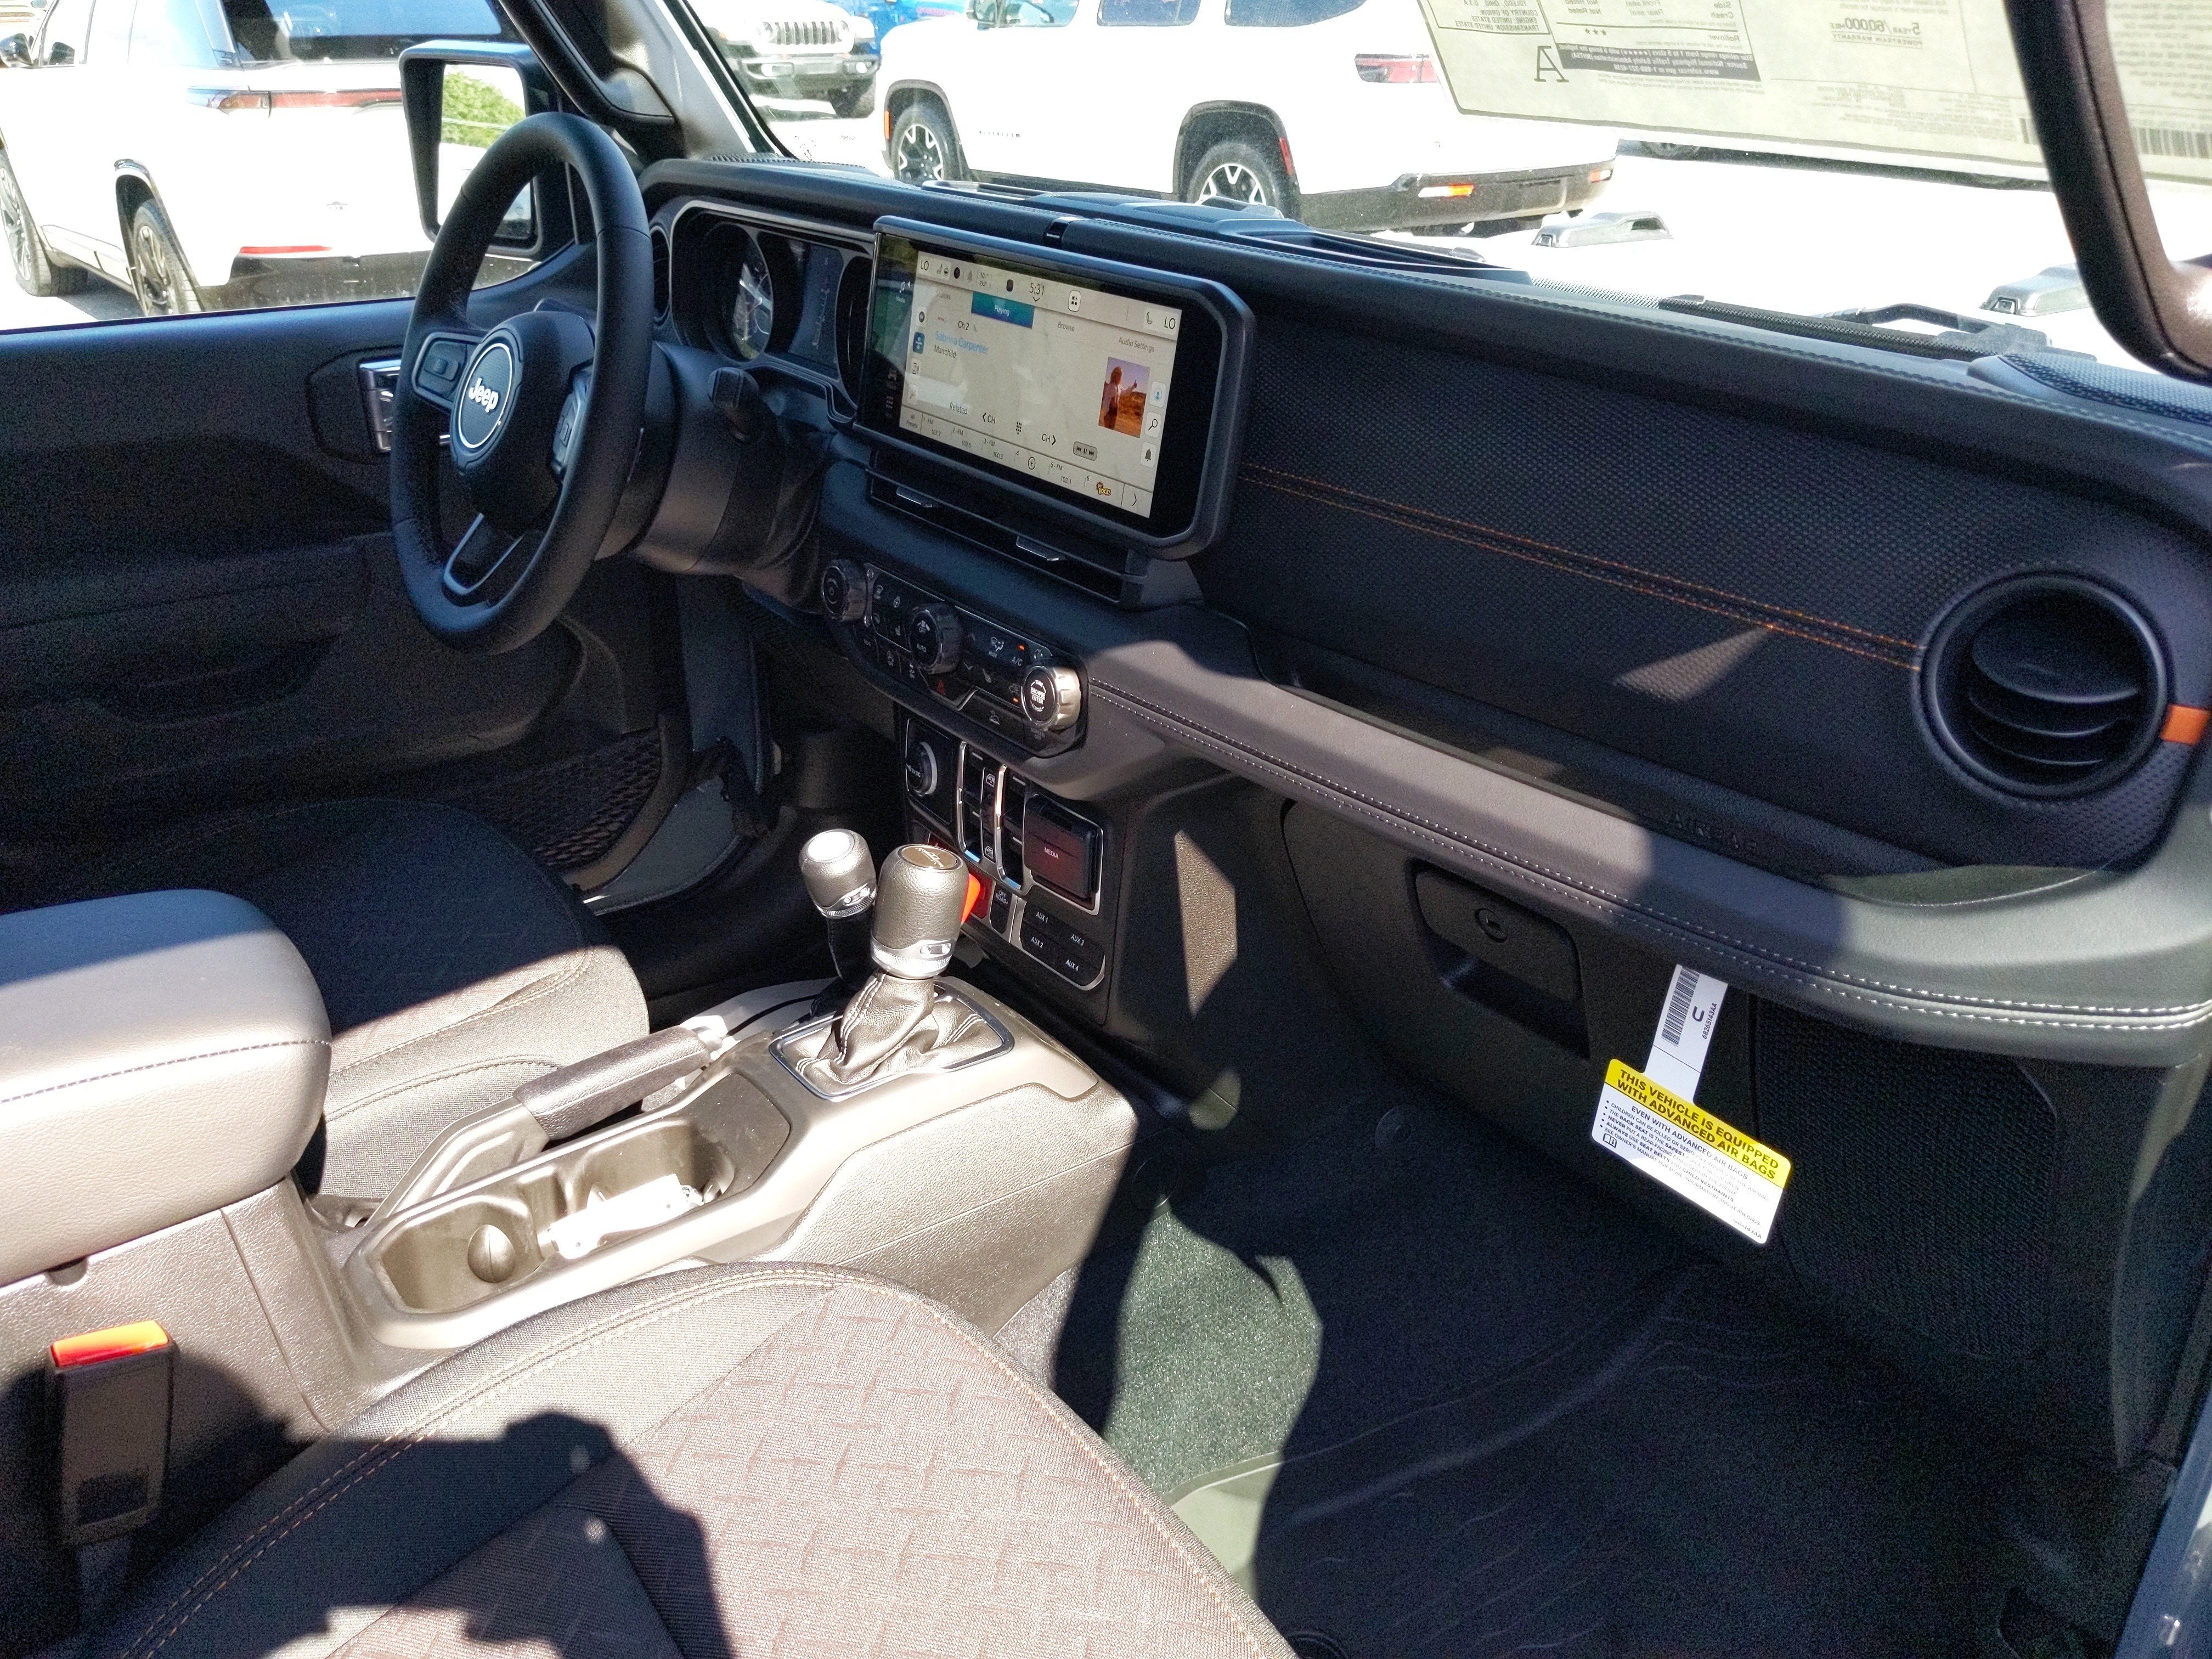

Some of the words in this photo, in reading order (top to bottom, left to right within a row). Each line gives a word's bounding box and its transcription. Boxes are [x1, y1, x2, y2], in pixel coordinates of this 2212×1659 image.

[921, 259, 929, 270] LO
[1029, 283, 1045, 296] 5:31
[994, 305, 1010, 317] Playing
[957, 320, 965, 329] Ch
[966, 322, 969, 330] 2
[1057, 320, 1075, 332] Browse
[1164, 317, 1176, 330] LO
[1118, 336, 1133, 347] Audio
[1133, 340, 1155, 353] Settings
[934, 345, 956, 358] Manchild
[469, 377, 499, 413] Jeep
[949, 402, 968, 415] Related
[987, 415, 995, 424] CH
[1041, 433, 1051, 443] CH
[1044, 847, 1059, 859] MEDIA
[1036, 911, 1045, 919] AUX
[1031, 936, 1040, 945] AUX
[1071, 934, 1081, 943] AUX
[1066, 960, 1075, 968] AUX
[1692, 1006, 1705, 1022] U
[1702, 1003, 1718, 1039] 68265143AA
[1611, 1102, 1635, 1120] CHILDREN
[1635, 1117, 1646, 1127] CAN
[1654, 1128, 1671, 1142] KILLED
[1618, 1068, 1647, 1091] THIS
[1647, 1086, 1699, 1122] VEHICLE
[1701, 1117, 1714, 1131] IS
[1715, 1126, 1779, 1170] EQUIPPED
[1607, 1115, 1626, 1128] NEVER
[1626, 1126, 1635, 1135] PUT
[1641, 1135, 1672, 1156] REAR-FACING
[1609, 1108, 1619, 1117] THE
[1619, 1114, 1634, 1126] BACK
[1635, 1124, 1648, 1135] SEAT
[1654, 1136, 1664, 1145] THE
[1664, 1142, 1684, 1157] SAFEST
[1616, 1078, 1647, 1103] WITH
[1649, 1098, 1716, 1144] ADVANCED
[1717, 1138, 1739, 1158] AIR
[1741, 1153, 1776, 1180] BAGS
[1604, 1127, 1613, 1135] SEE
[1614, 1132, 1636, 1149] OWNER'S
[1637, 1147, 1656, 1161] MANUAL
[1631, 1105, 1650, 1121] EVEN
[1651, 1117, 1671, 1133] WITH
[1671, 1130, 1712, 1158] ADVANCED
[1713, 1155, 1726, 1166] AIR
[1727, 1163, 1748, 1180] BAGS
[1606, 1121, 1628, 1137] ALWAYS
[1628, 1135, 1638, 1143] USE
[1639, 1141, 1653, 1152] SEAT
[1654, 1150, 1669, 1163] BELTS
[1681, 1167, 1699, 1181] CHILD
[1700, 1178, 1734, 1202] RESTRAINTS
